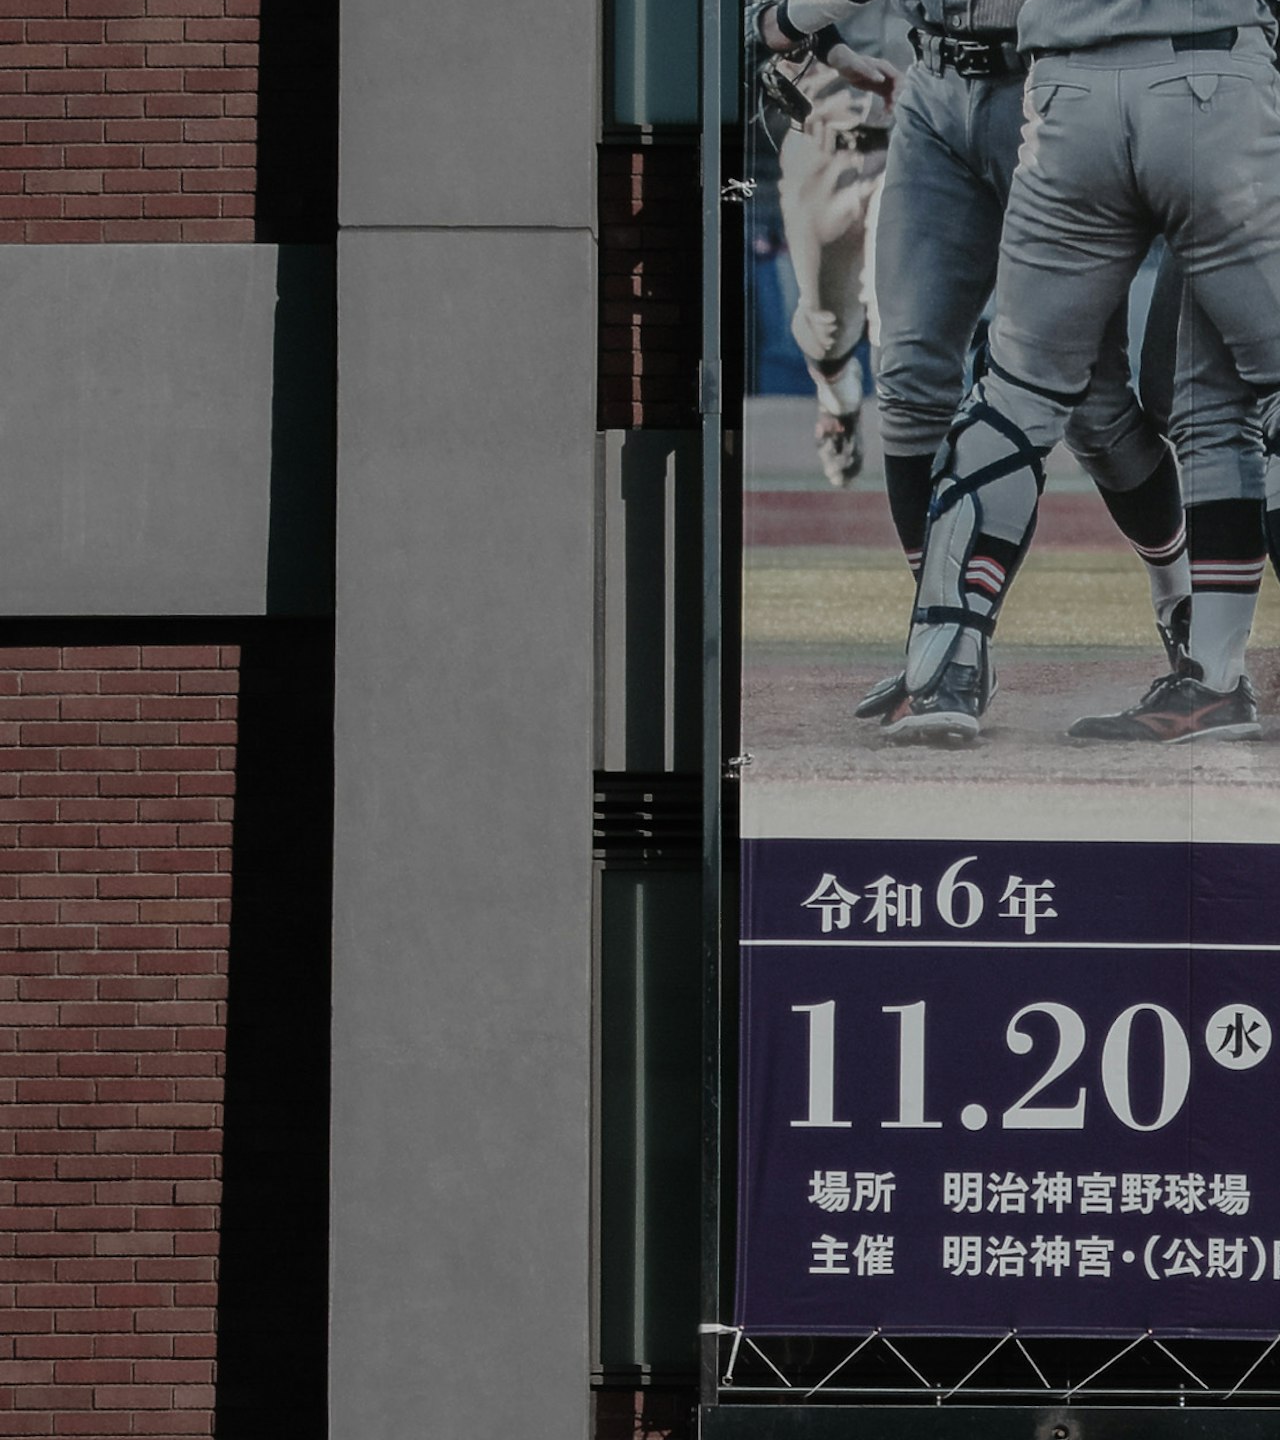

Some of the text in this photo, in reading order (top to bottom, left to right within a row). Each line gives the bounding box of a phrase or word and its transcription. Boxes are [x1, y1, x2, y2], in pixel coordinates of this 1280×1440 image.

[800, 854, 1059, 936] 令和6年
[789, 999, 1191, 1132] 11.20
[808, 1169, 1251, 1217] 場所 明治神宮野球場
[808, 1234, 896, 1278] 主催
